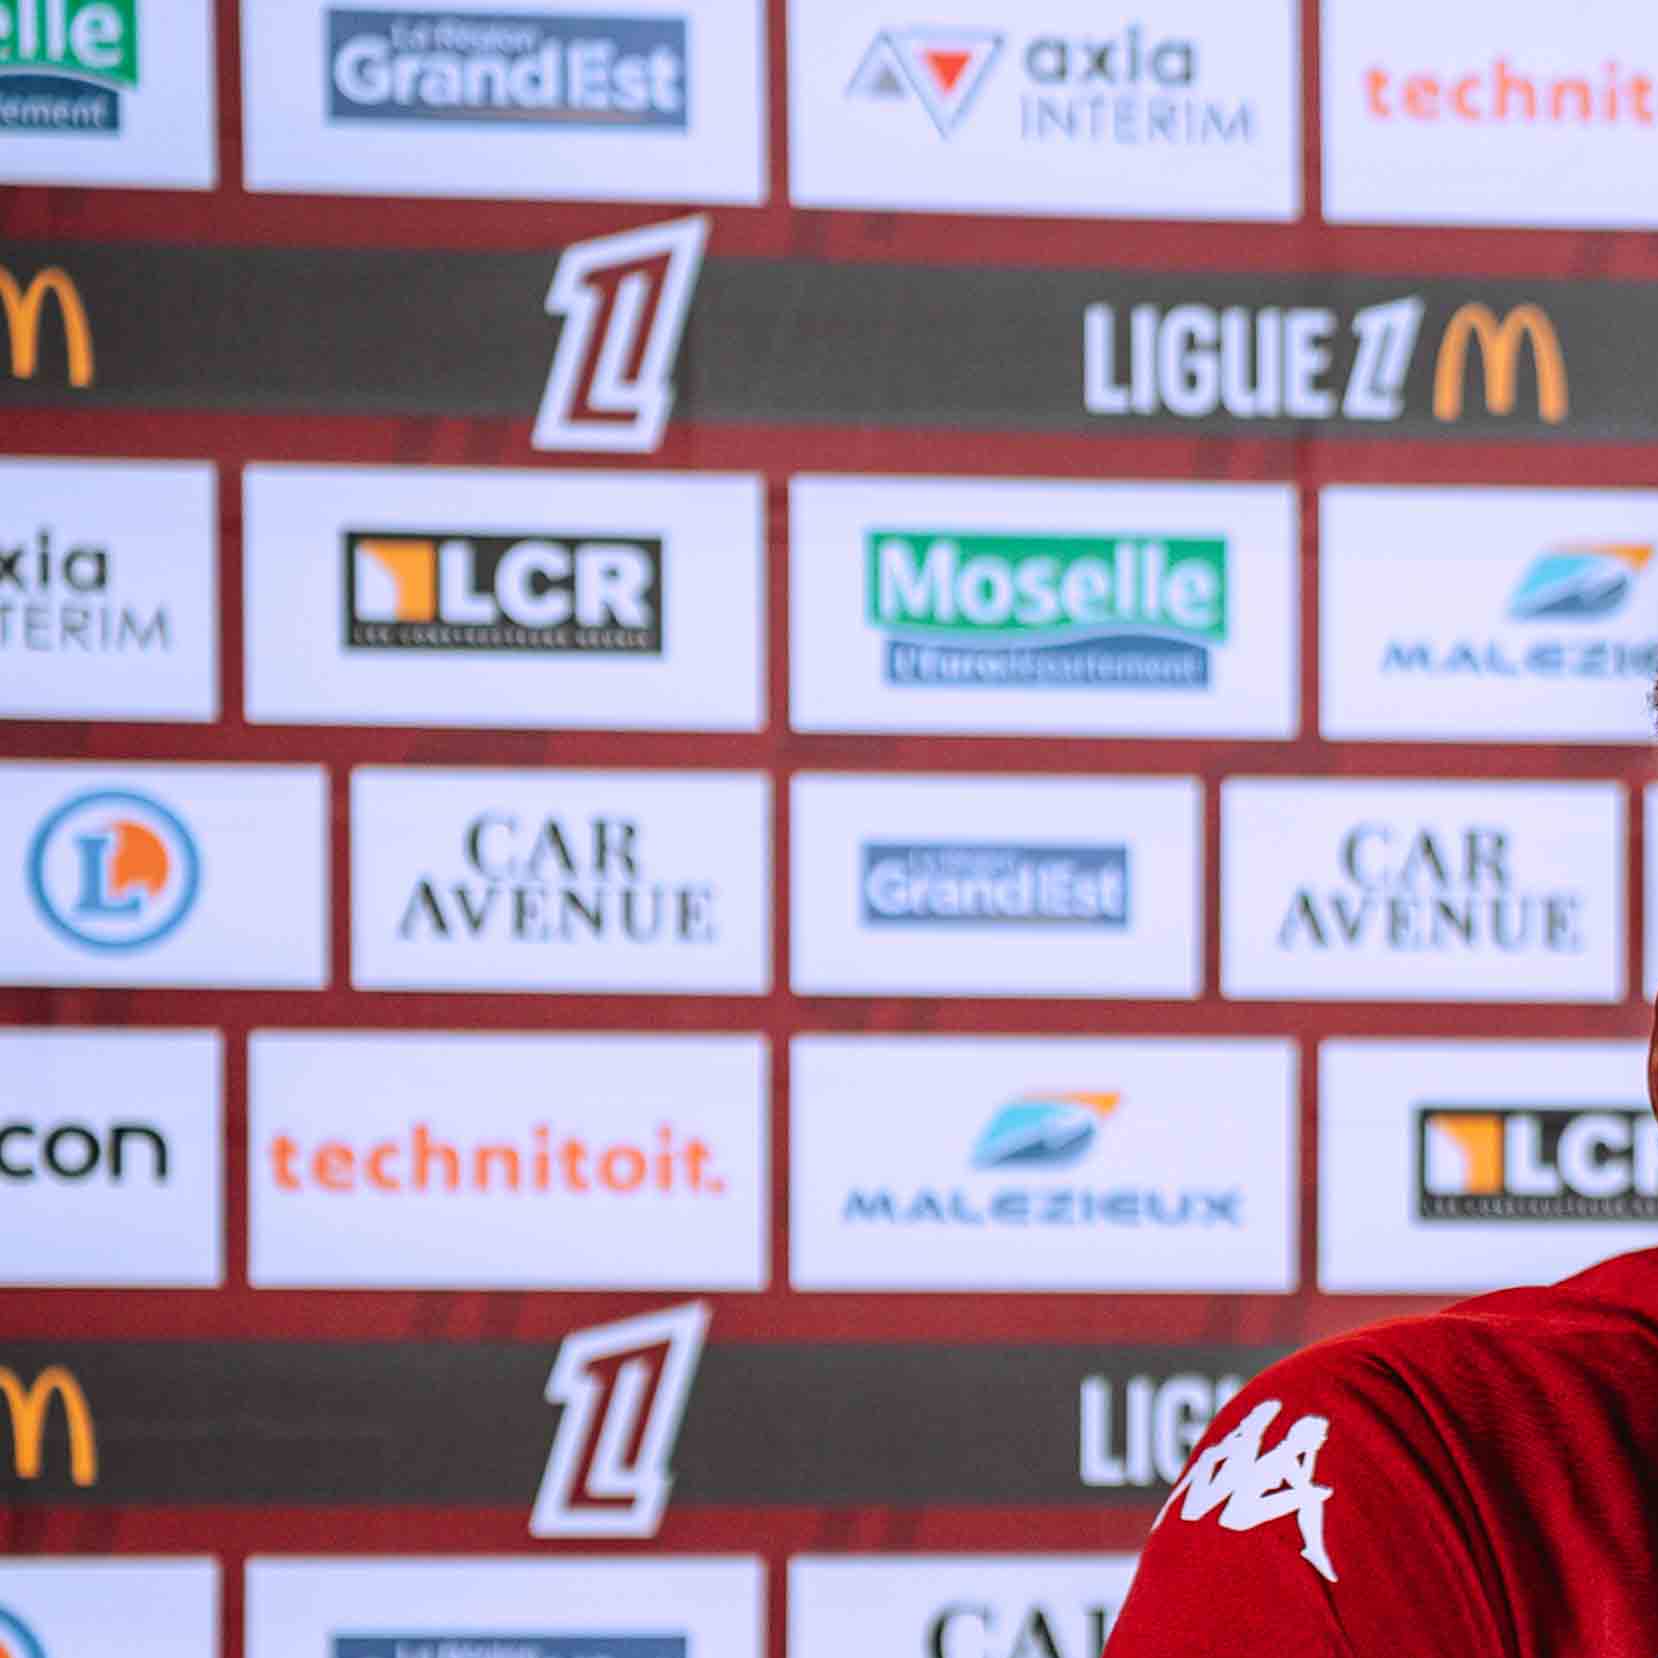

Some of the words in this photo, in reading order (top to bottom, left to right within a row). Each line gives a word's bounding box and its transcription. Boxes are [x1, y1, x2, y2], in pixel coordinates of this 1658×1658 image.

[1025, 27, 1197, 86] axia
[1021, 95, 1253, 144] INTERIM
[438, 540, 653, 628] LCR
[879, 538, 1216, 630] Moselle
[467, 815, 641, 879] CAR
[1341, 825, 1511, 895] CAR
[400, 881, 717, 944] AVENUE
[1278, 891, 1584, 952] AVENUE
[845, 1187, 1245, 1225] MALEZIEUX
[1080, 1373, 1243, 1487] LIG
